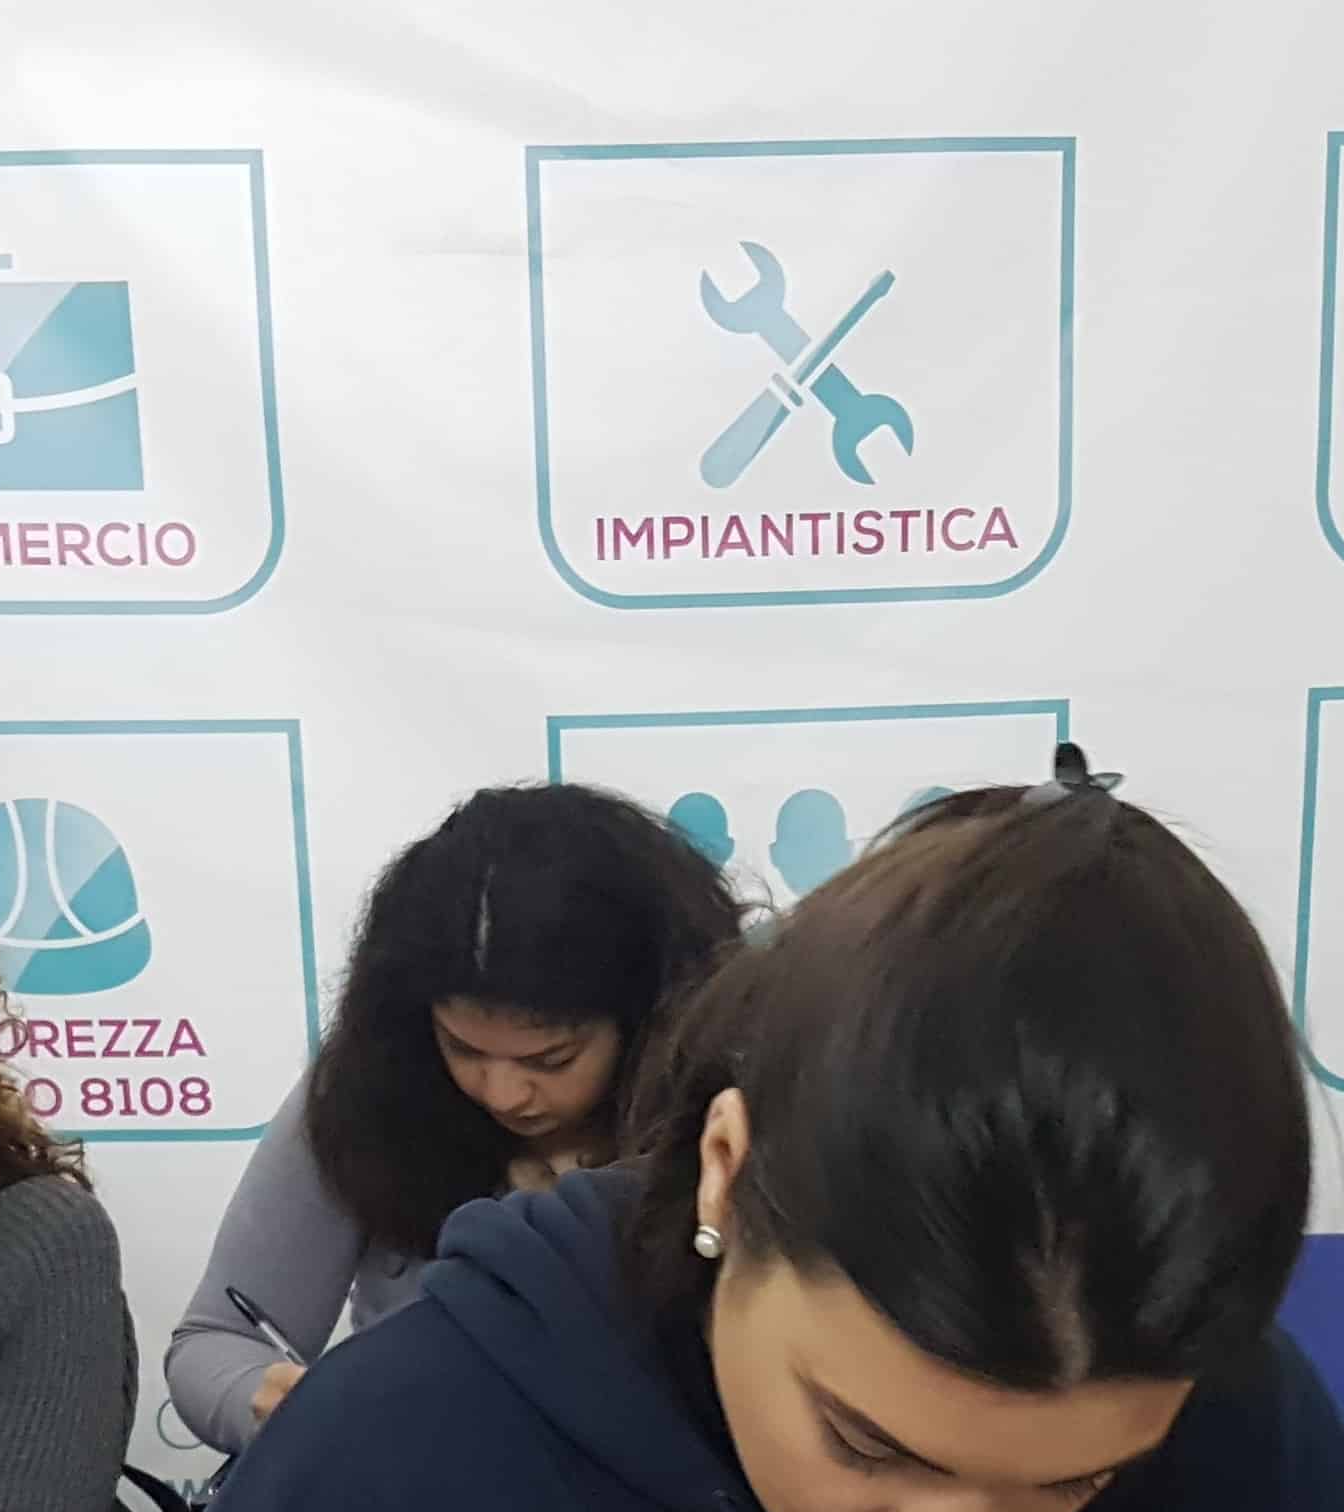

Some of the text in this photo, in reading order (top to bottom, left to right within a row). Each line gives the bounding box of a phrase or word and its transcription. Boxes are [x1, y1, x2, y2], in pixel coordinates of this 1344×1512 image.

[595, 507, 1019, 561] IMPIANTISTICA
[0, 1018, 208, 1058] REZZA
[80, 1077, 212, 1117] 8108
